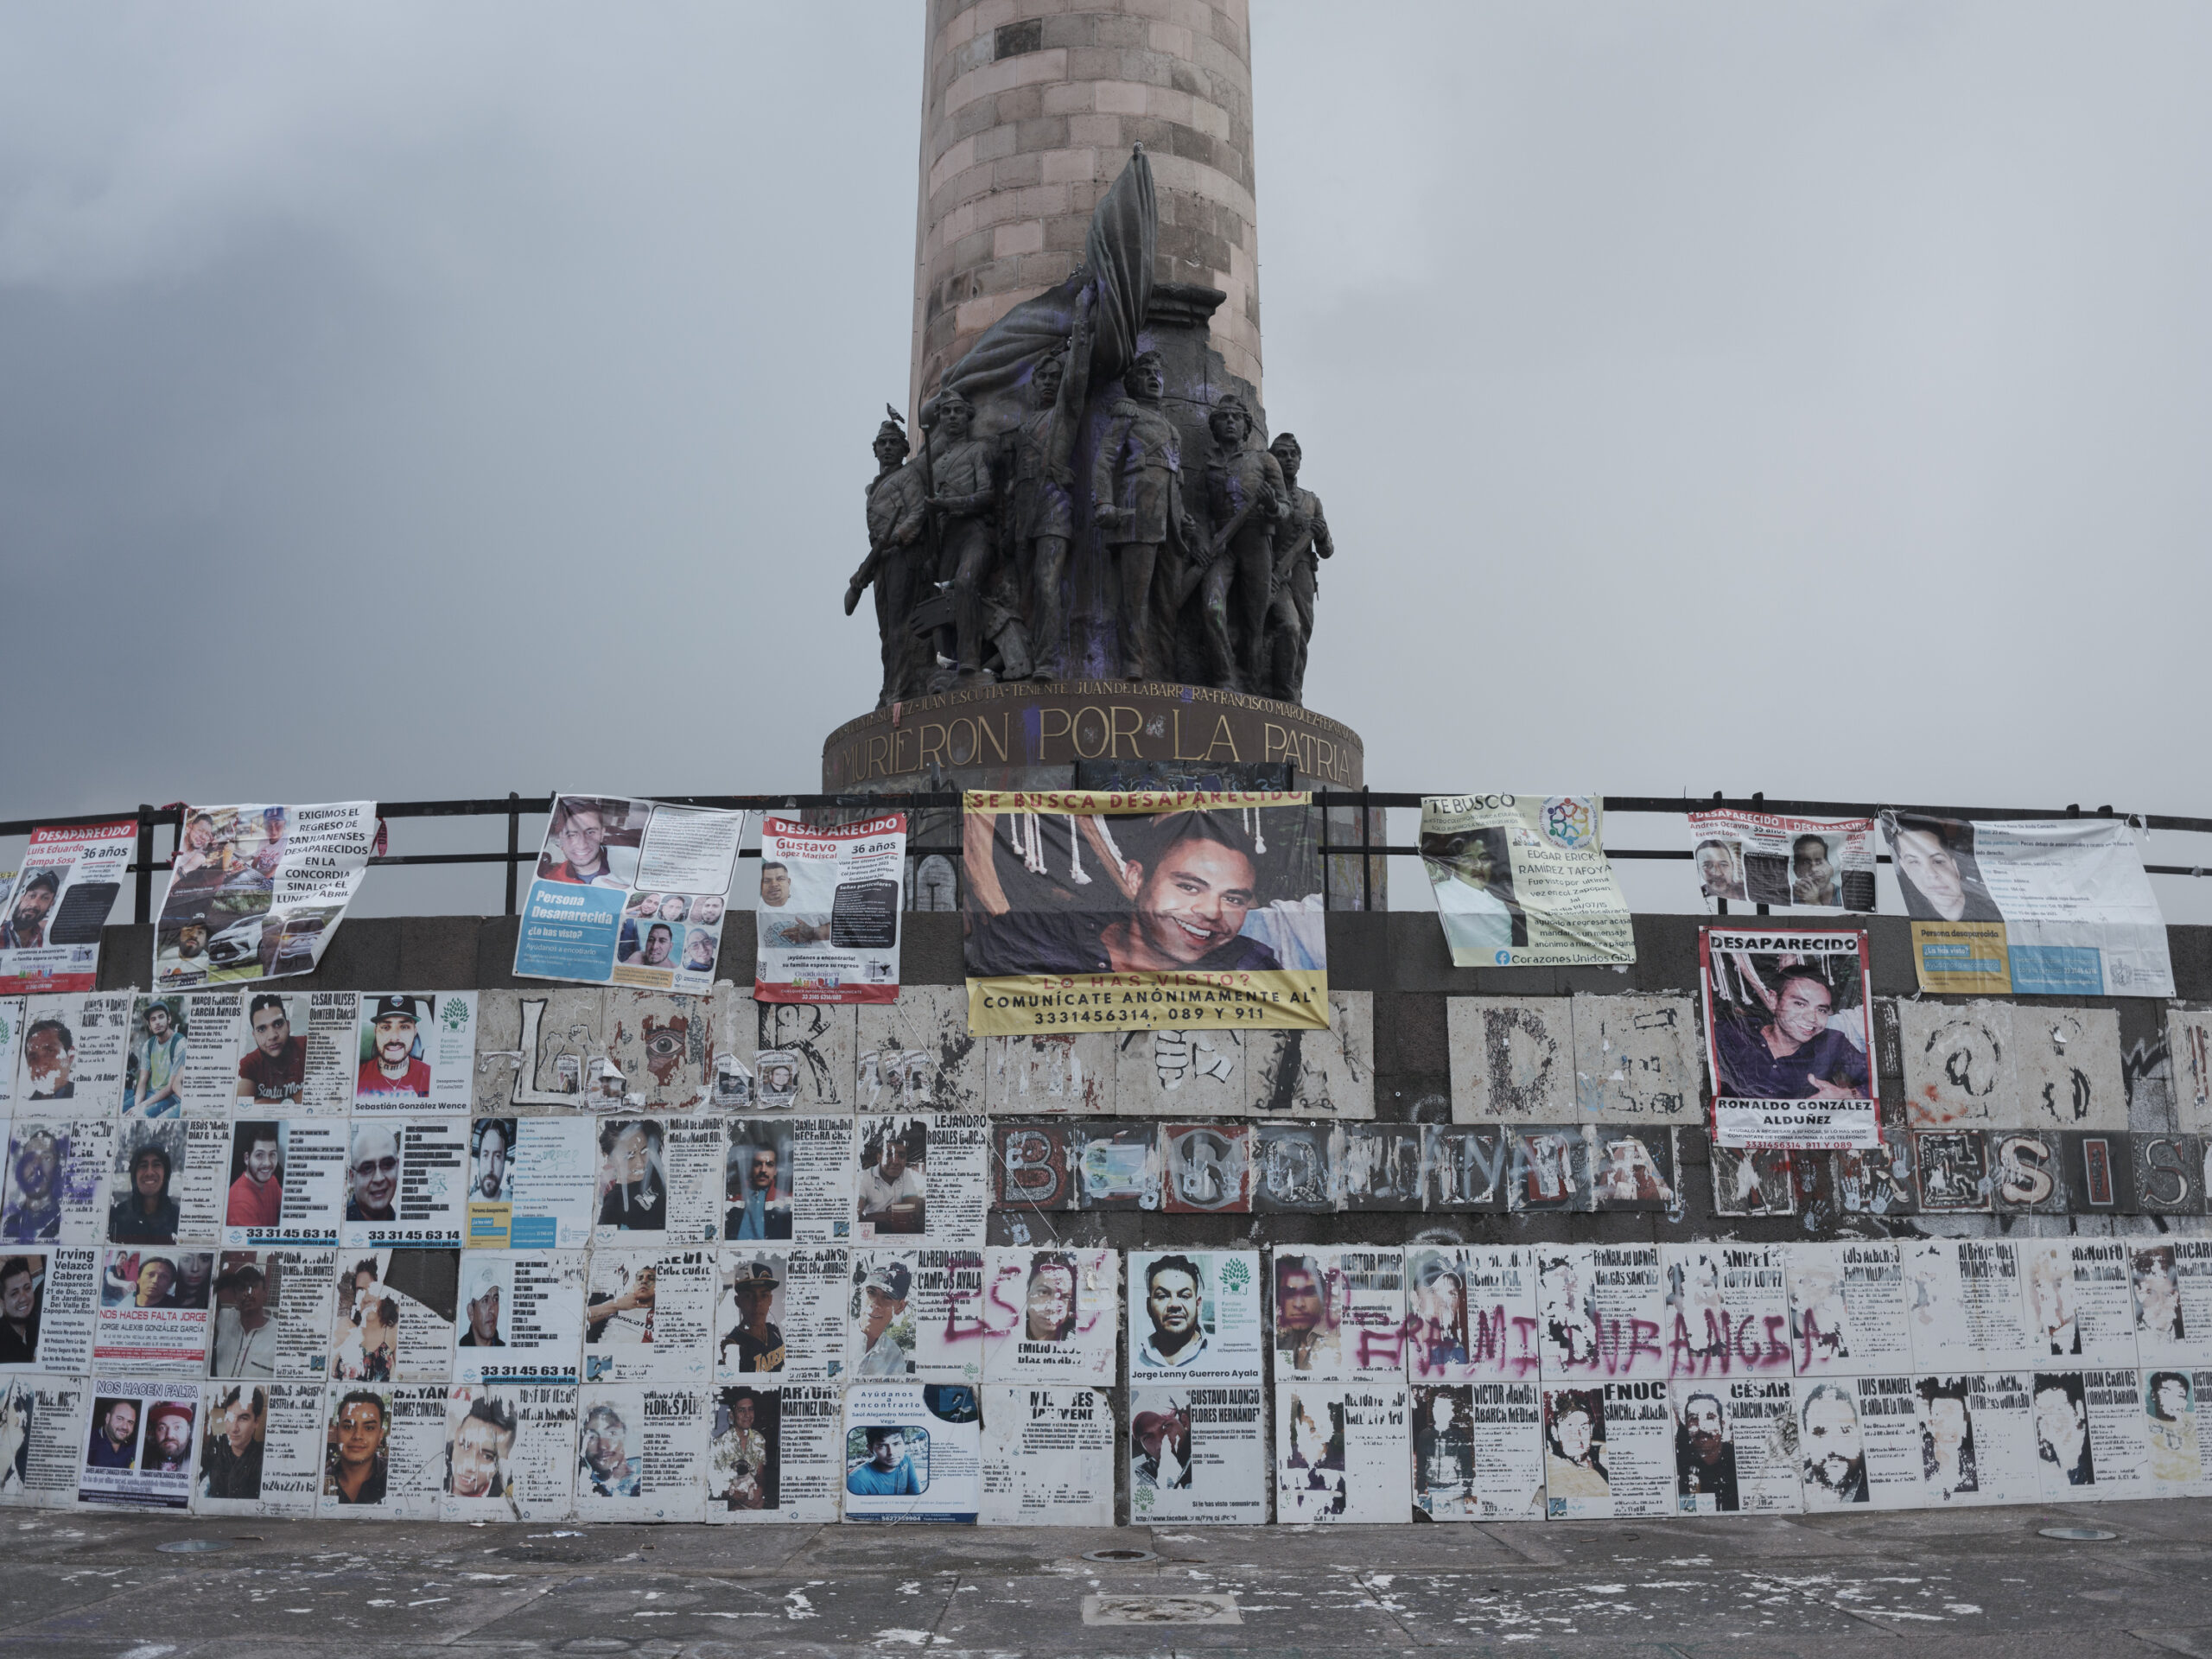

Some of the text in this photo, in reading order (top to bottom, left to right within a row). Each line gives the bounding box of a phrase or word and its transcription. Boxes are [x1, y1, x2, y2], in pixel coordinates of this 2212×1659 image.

[877, 703, 913, 723] SUAEZ
[918, 696, 946, 711] JUAN
[950, 685, 1004, 705] ESCUTIA
[1011, 683, 1067, 696] TENIENTE
[1076, 681, 1112, 695] JUAN
[1212, 690, 1274, 713] FRANCISCO
[1275, 702, 1319, 727] MARQUEZ
[842, 706, 1351, 788] MURIERON POR LA PATRIA
[973, 791, 1304, 809] SE BUSCA DESAPARECIDO
[1431, 794, 1515, 814] TE BUSCO
[299, 808, 359, 819] EXIGIMOS EL
[1696, 810, 1779, 826] DESAPARECIDO
[299, 820, 358, 832] REGRESO DE
[775, 817, 898, 836] DESAPARECIDO
[38, 825, 130, 842] DESAPARECIDO
[289, 832, 365, 845] SANJUANENSES
[27, 843, 85, 855] Luis Eduardo
[284, 845, 368, 855] DESAPARECIDOS
[776, 837, 836, 852] Gustavo
[852, 841, 896, 854] 36 años
[81, 846, 129, 859] 36 años
[776, 850, 800, 860] Lopez
[1528, 850, 1560, 861] EDGAR
[26, 857, 54, 867] Campa
[305, 857, 335, 866] EN LA
[1519, 862, 1611, 874] RAMÍREZ TAFOYA
[285, 869, 350, 879] CONCORDIA
[334, 880, 346, 888] EL
[537, 890, 585, 906] Persona
[531, 906, 613, 925] Desaparecida
[528, 926, 582, 939] ¿Lo has visto?
[1951, 930, 1998, 938] desaparecida
[1711, 937, 1858, 950] DESAPARECIDO
[1512, 955, 1571, 963] Corazones
[1044, 973, 1251, 989] LO HAS VISTO?
[311, 993, 355, 1007] CÉSAR ULISES
[983, 987, 1312, 1008] COMUNÍCATE ANÓNIMAMENTE AL
[309, 1008, 335, 1020] QUINTERO
[1034, 1007, 1264, 1025] 3331456314, 089 Y 911
[355, 1102, 397, 1110] Sebastián
[1719, 1099, 1872, 1110] RONALDO GONZÁLEZ
[1764, 1114, 1831, 1125] ALDUÑEZ
[246, 1229, 337, 1238] 33 31 45 63 14
[55, 1249, 94, 1262] Irving
[918, 1250, 949, 1268] ALFREDO
[1377, 1253, 1403, 1271] HUGO
[54, 1261, 93, 1270] Velazco
[53, 1271, 93, 1281] Cabrera
[918, 1272, 982, 1290] CAMPOS AYALA
[1370, 1274, 1403, 1290] ALVARADO
[99, 1310, 207, 1322] NOS HACES FALTA JORGE
[145, 1321, 179, 1332] GONZÁLEZ
[180, 1323, 204, 1332] GARCÍA
[1132, 1369, 1259, 1380] Jorge Lenny Guerrero Ayala
[97, 1382, 198, 1398] NOS HACEN FALTA
[1604, 1382, 1667, 1401] ENOC
[1878, 1377, 1912, 1395] MANUEL
[1191, 1389, 1227, 1405] GUSTAVO
[1473, 1384, 1503, 1405] VICTOR
[1191, 1408, 1217, 1422] FLORES
